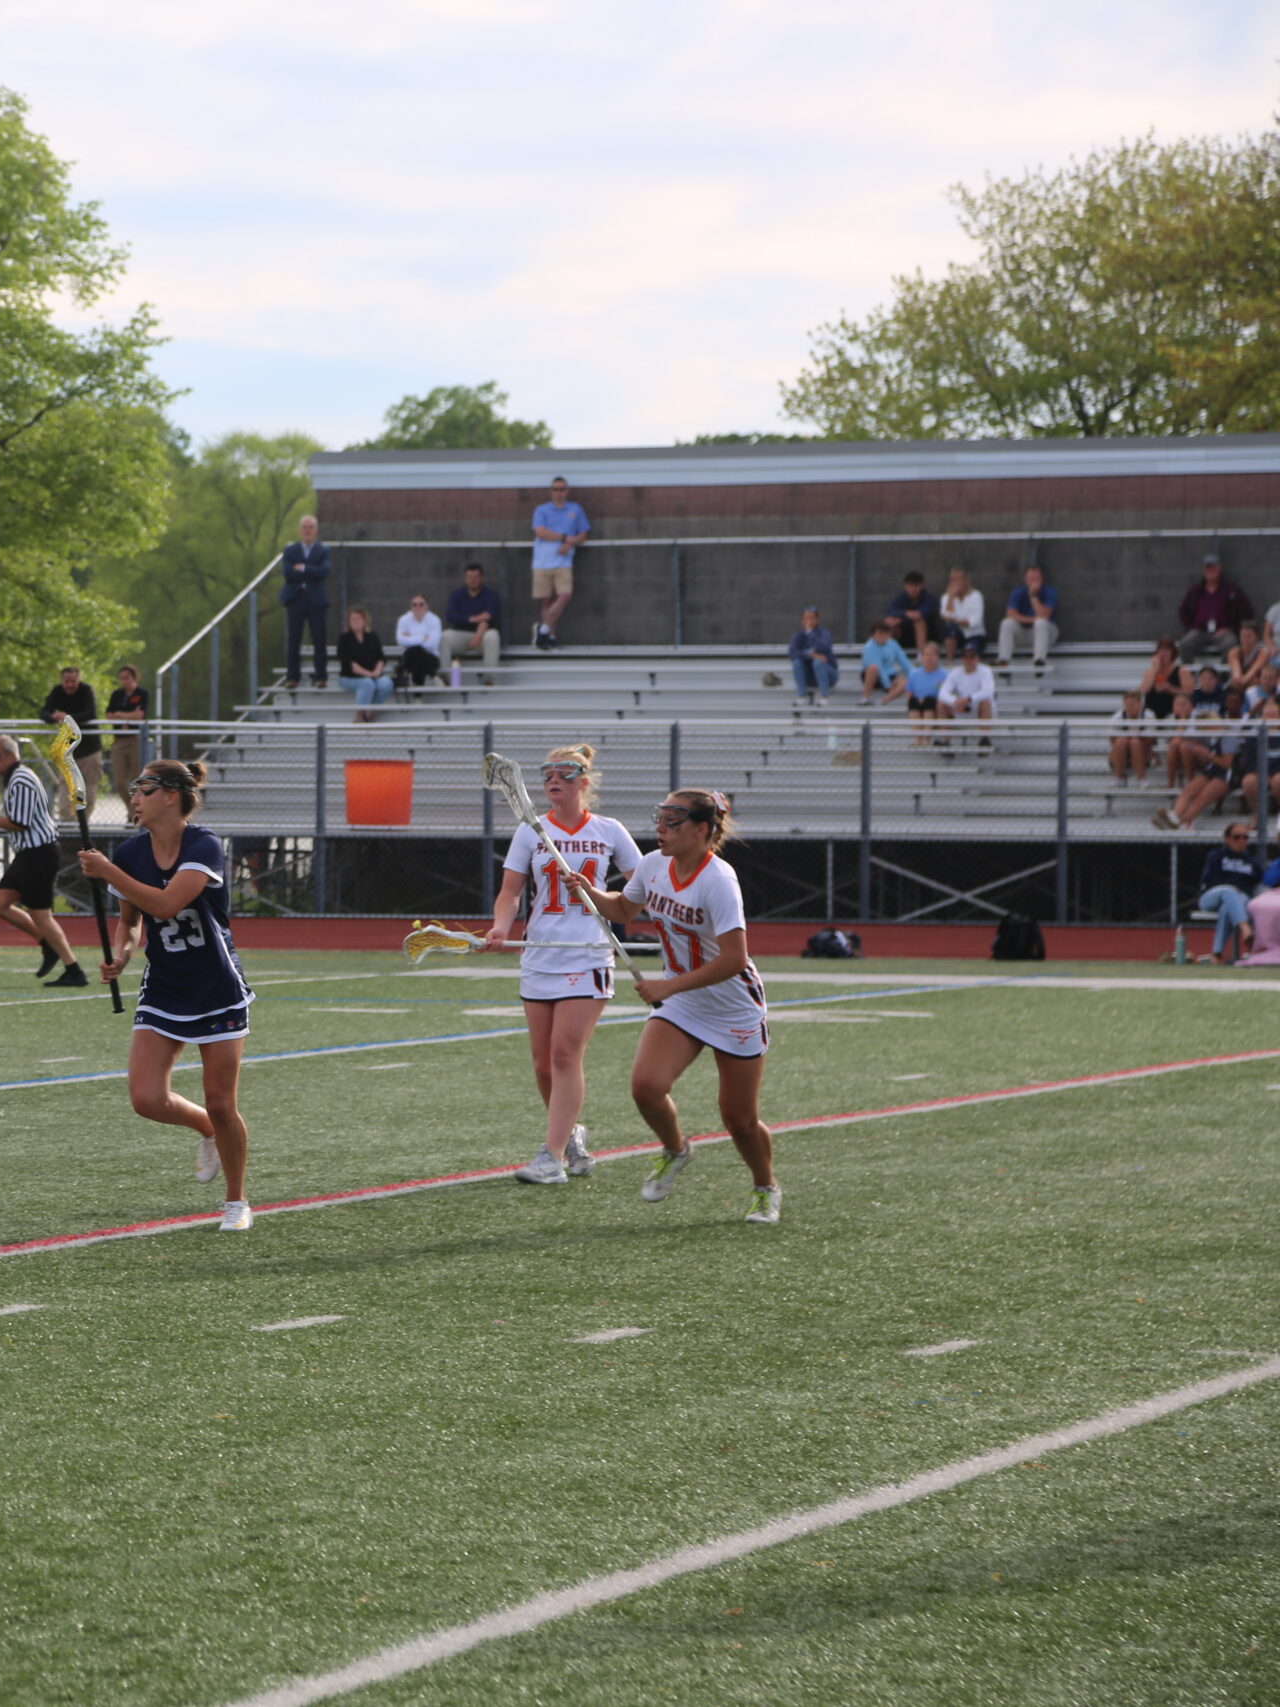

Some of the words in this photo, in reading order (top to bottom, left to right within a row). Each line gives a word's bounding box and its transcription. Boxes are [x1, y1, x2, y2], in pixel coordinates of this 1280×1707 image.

[541, 857, 599, 915] 14
[647, 889, 704, 926] PANTHERS
[154, 908, 206, 953] 23
[653, 917, 704, 975] 17
